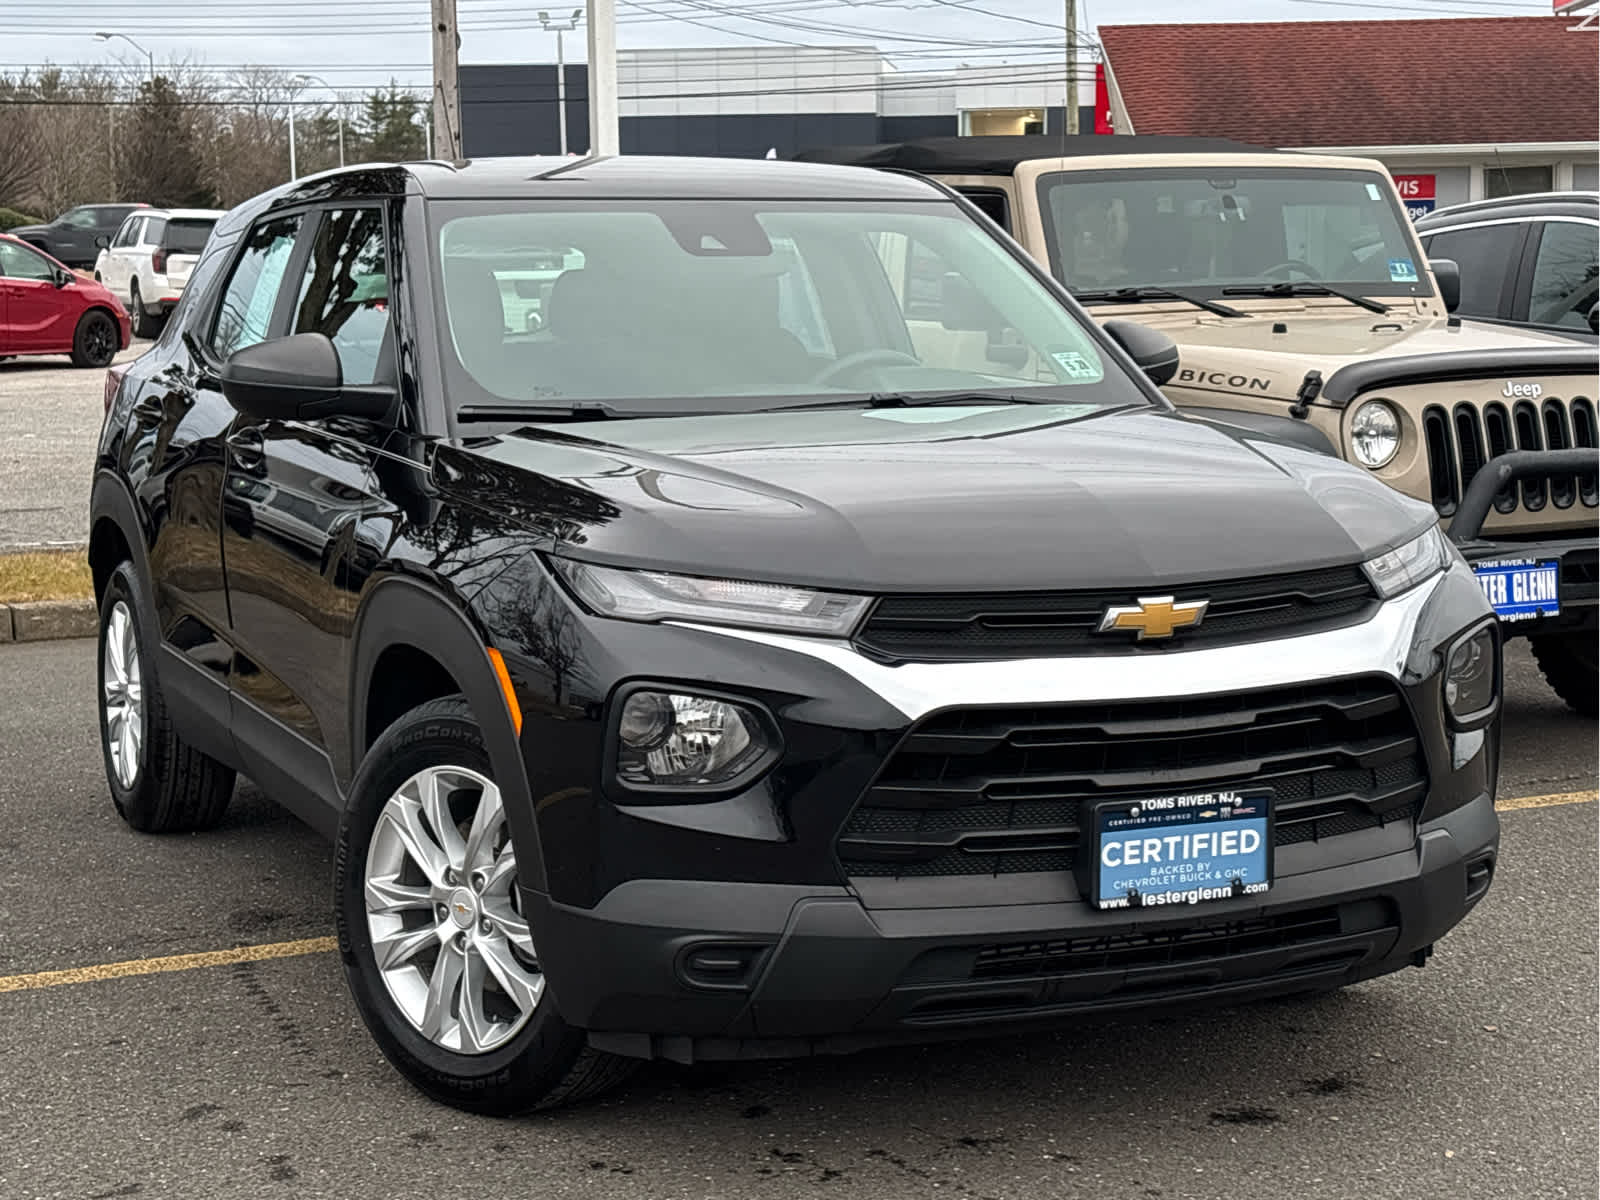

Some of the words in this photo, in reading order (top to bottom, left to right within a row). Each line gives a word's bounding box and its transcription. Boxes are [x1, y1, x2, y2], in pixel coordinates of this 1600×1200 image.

[1407, 205, 1428, 220] get
[1178, 369, 1272, 391] BICON
[1502, 380, 1542, 398] Jeep
[1478, 561, 1499, 569] TOMS
[1480, 574, 1507, 605] TER
[1512, 569, 1556, 602] GLENN
[1499, 611, 1537, 622] erglenn
[1140, 798, 1176, 812] TOMS
[1177, 794, 1217, 808] RIVER,
[1218, 792, 1236, 804] NJ
[1108, 816, 1147, 827] CERTIFIED
[1148, 812, 1192, 823] PRE-OWNED
[1232, 806, 1257, 815] GMC
[1101, 829, 1260, 867] CERTIFIED
[1113, 874, 1176, 890] CHEVROLET
[1180, 870, 1212, 883] BUICK
[1214, 870, 1222, 880] &
[1224, 866, 1248, 879] GMC
[1150, 864, 1193, 876] BACKED
[1197, 862, 1211, 872] BY
[1100, 897, 1130, 909] www.
[1141, 886, 1232, 905] lesterglenn
[1242, 882, 1269, 894] .com
